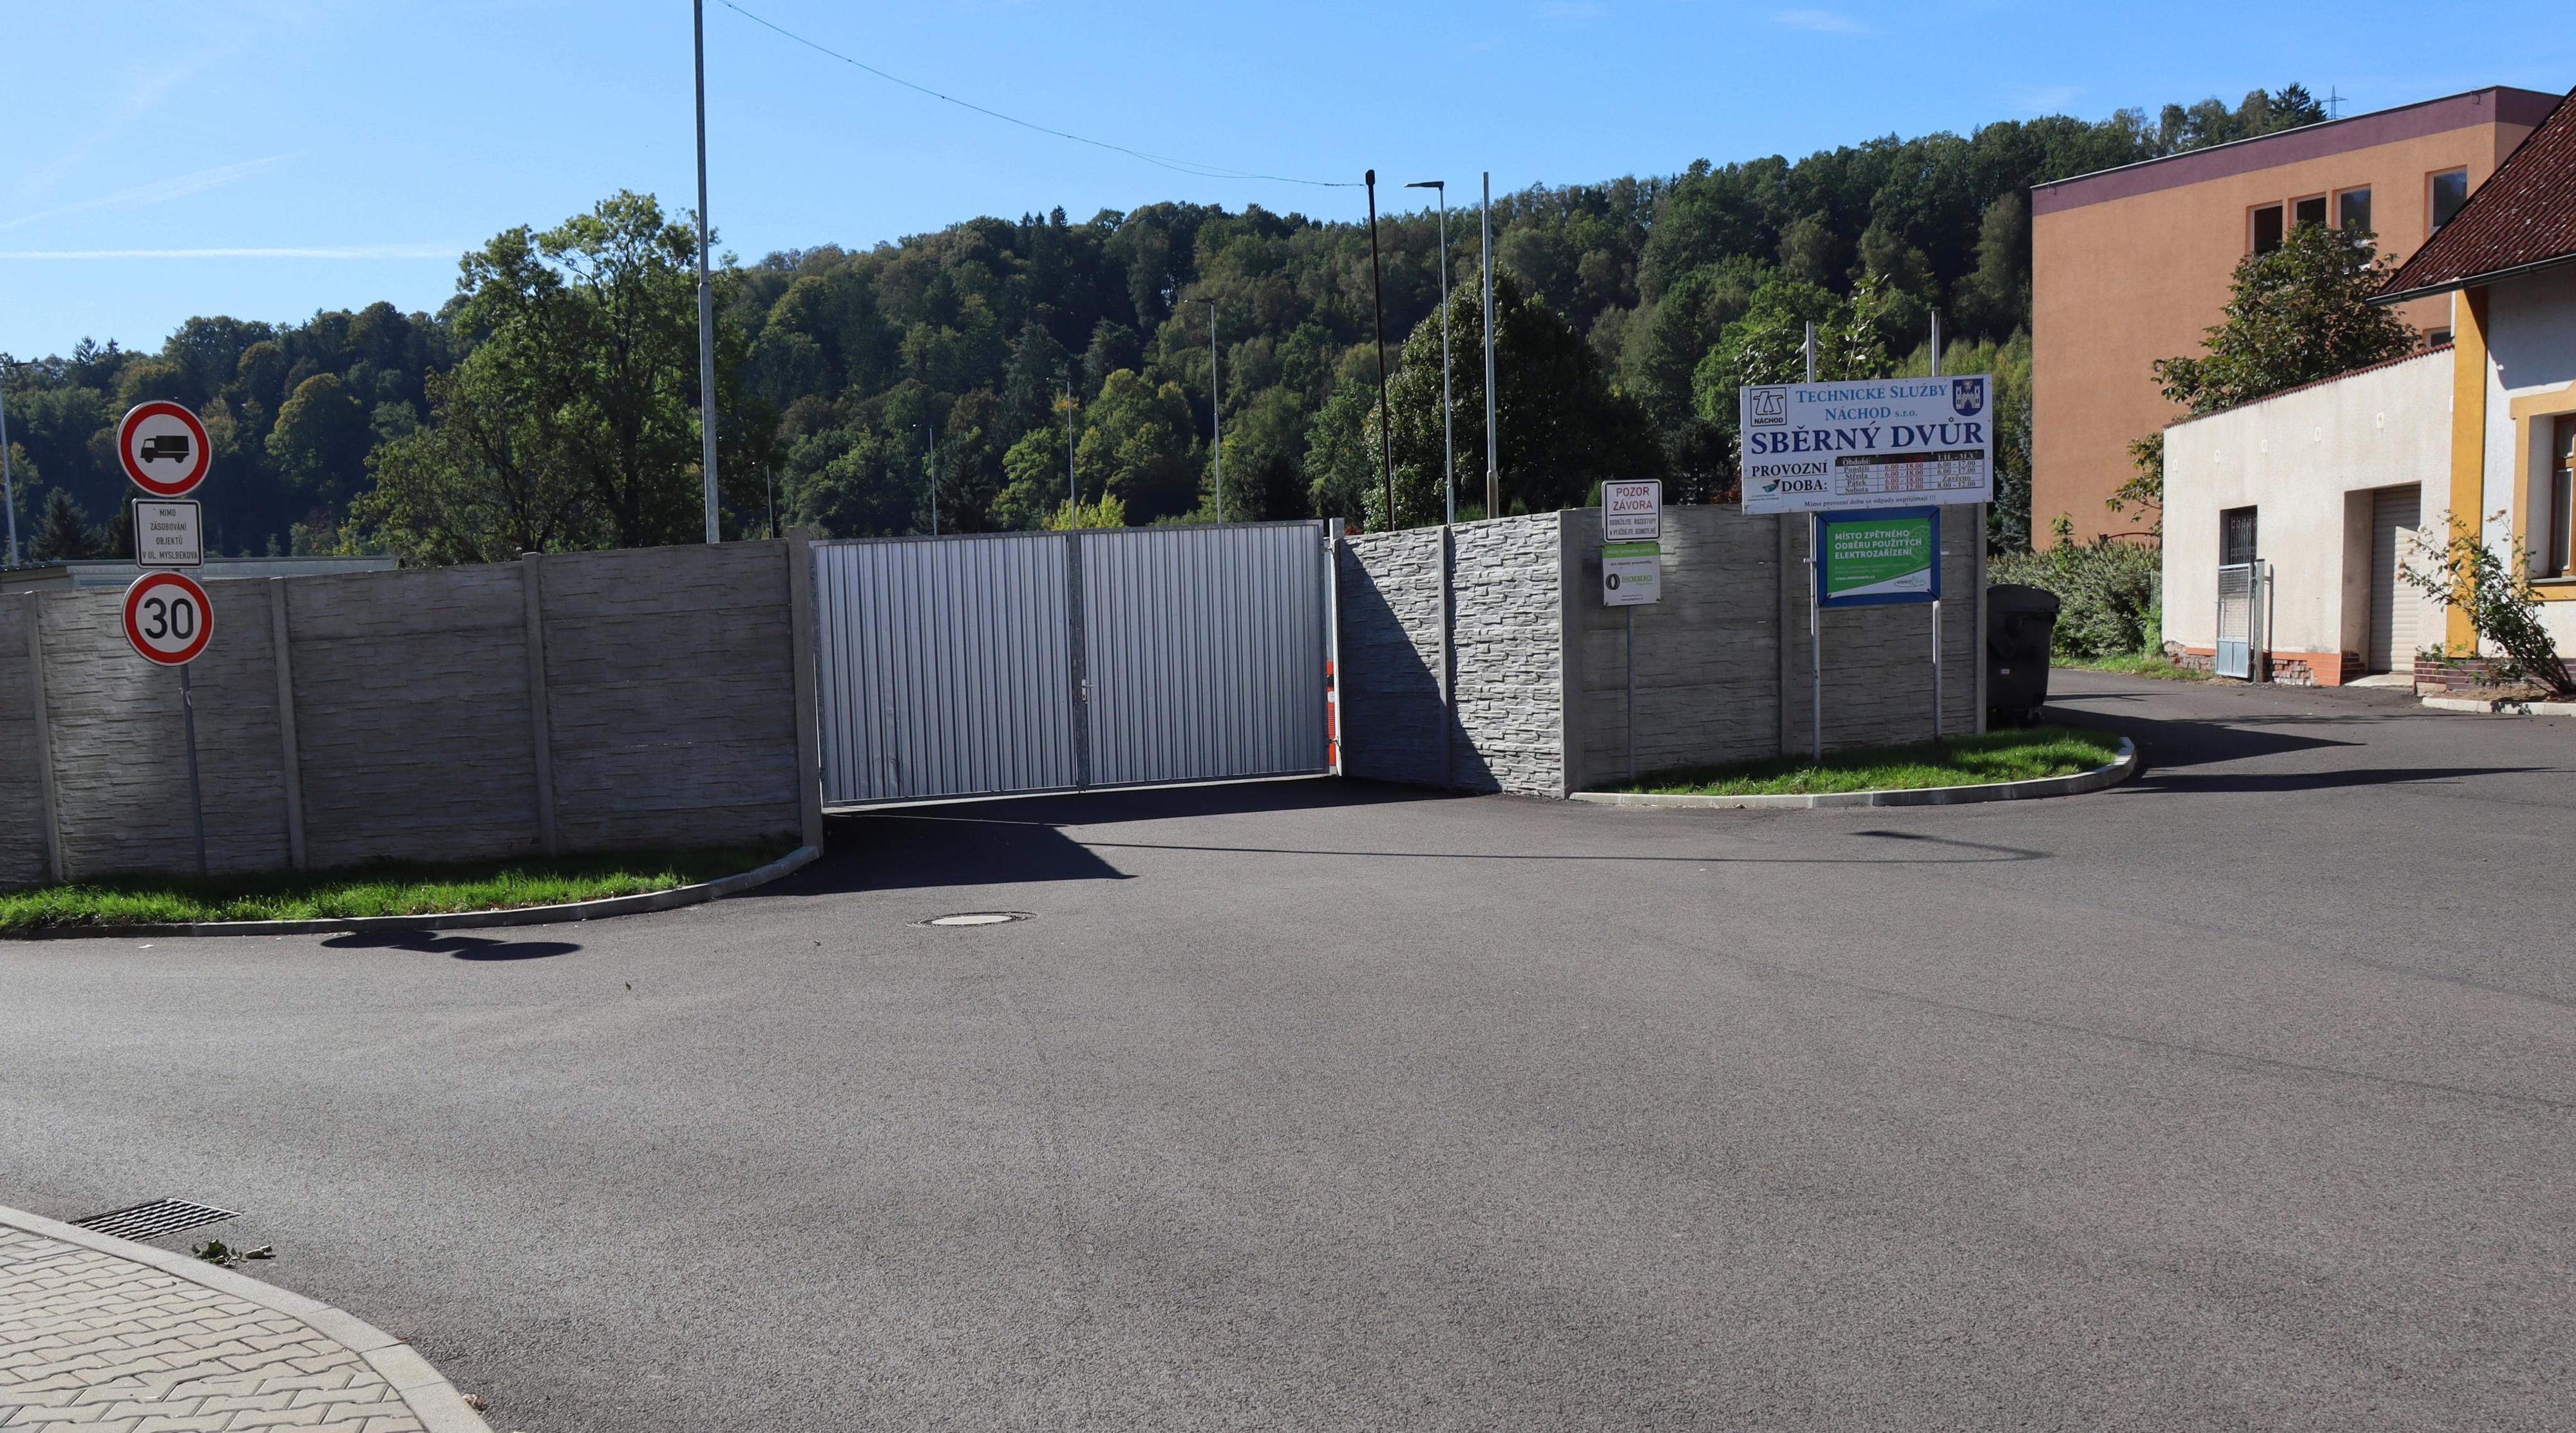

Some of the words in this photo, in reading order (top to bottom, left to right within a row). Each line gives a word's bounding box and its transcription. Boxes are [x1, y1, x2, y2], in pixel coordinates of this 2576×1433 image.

[1795, 385, 1886, 403] TECHNICKÉ
[1890, 383, 1947, 398] SLUŽBY
[1825, 406, 1891, 421] NÁCHOD
[1750, 421, 1880, 455] SBĚRNÝ
[1891, 417, 1984, 448] DVŮR
[1842, 456, 1871, 466] Období:
[1752, 459, 1828, 477] PROVOZNÍ
[1616, 487, 1650, 497] POZOR
[1781, 479, 1828, 493] DOBA:
[1613, 498, 1653, 511] ZÁVORA
[151, 521, 187, 531] ZÁSOBOVÁNÍ
[156, 535, 183, 546] OBJEKTŮ
[1835, 531, 1862, 540] MÍSTO
[1864, 529, 1909, 539] ZPĚTNÉHO
[1835, 539, 1870, 549] ODBĚRU
[1872, 537, 1922, 548] POUŽITÝCH
[159, 551, 198, 560] MYSLBEKOVA
[1835, 547, 1912, 559] ELEKTROZAŘÍZENÍ
[144, 597, 194, 640] 30
